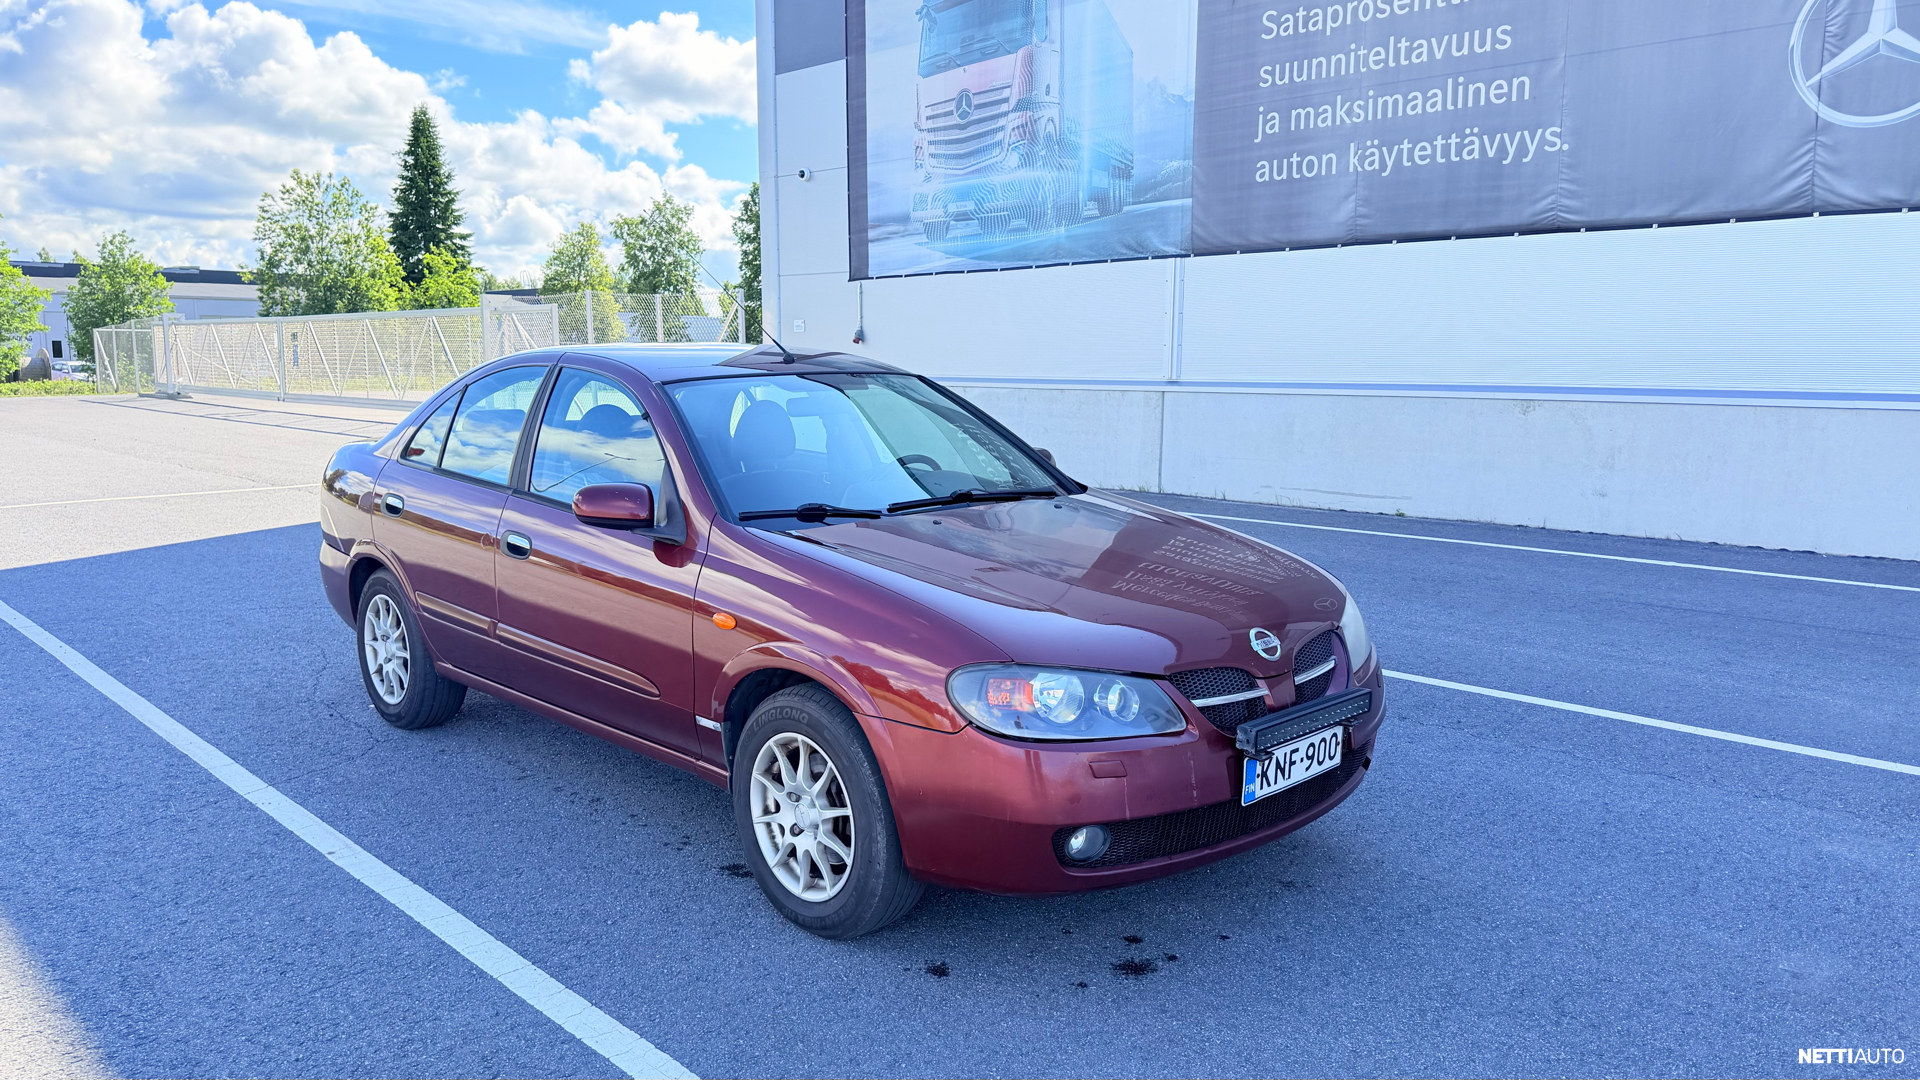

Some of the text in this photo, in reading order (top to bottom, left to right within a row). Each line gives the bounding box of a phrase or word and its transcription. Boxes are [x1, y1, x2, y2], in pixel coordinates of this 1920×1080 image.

[1259, 24, 1512, 87] suunniteltavuus
[1254, 75, 1530, 143] ja maksimaalinen
[1255, 126, 1569, 182] auton käytettävyys.
[753, 708, 809, 731] LINGLONG
[1260, 732, 1338, 790] KNF-900
